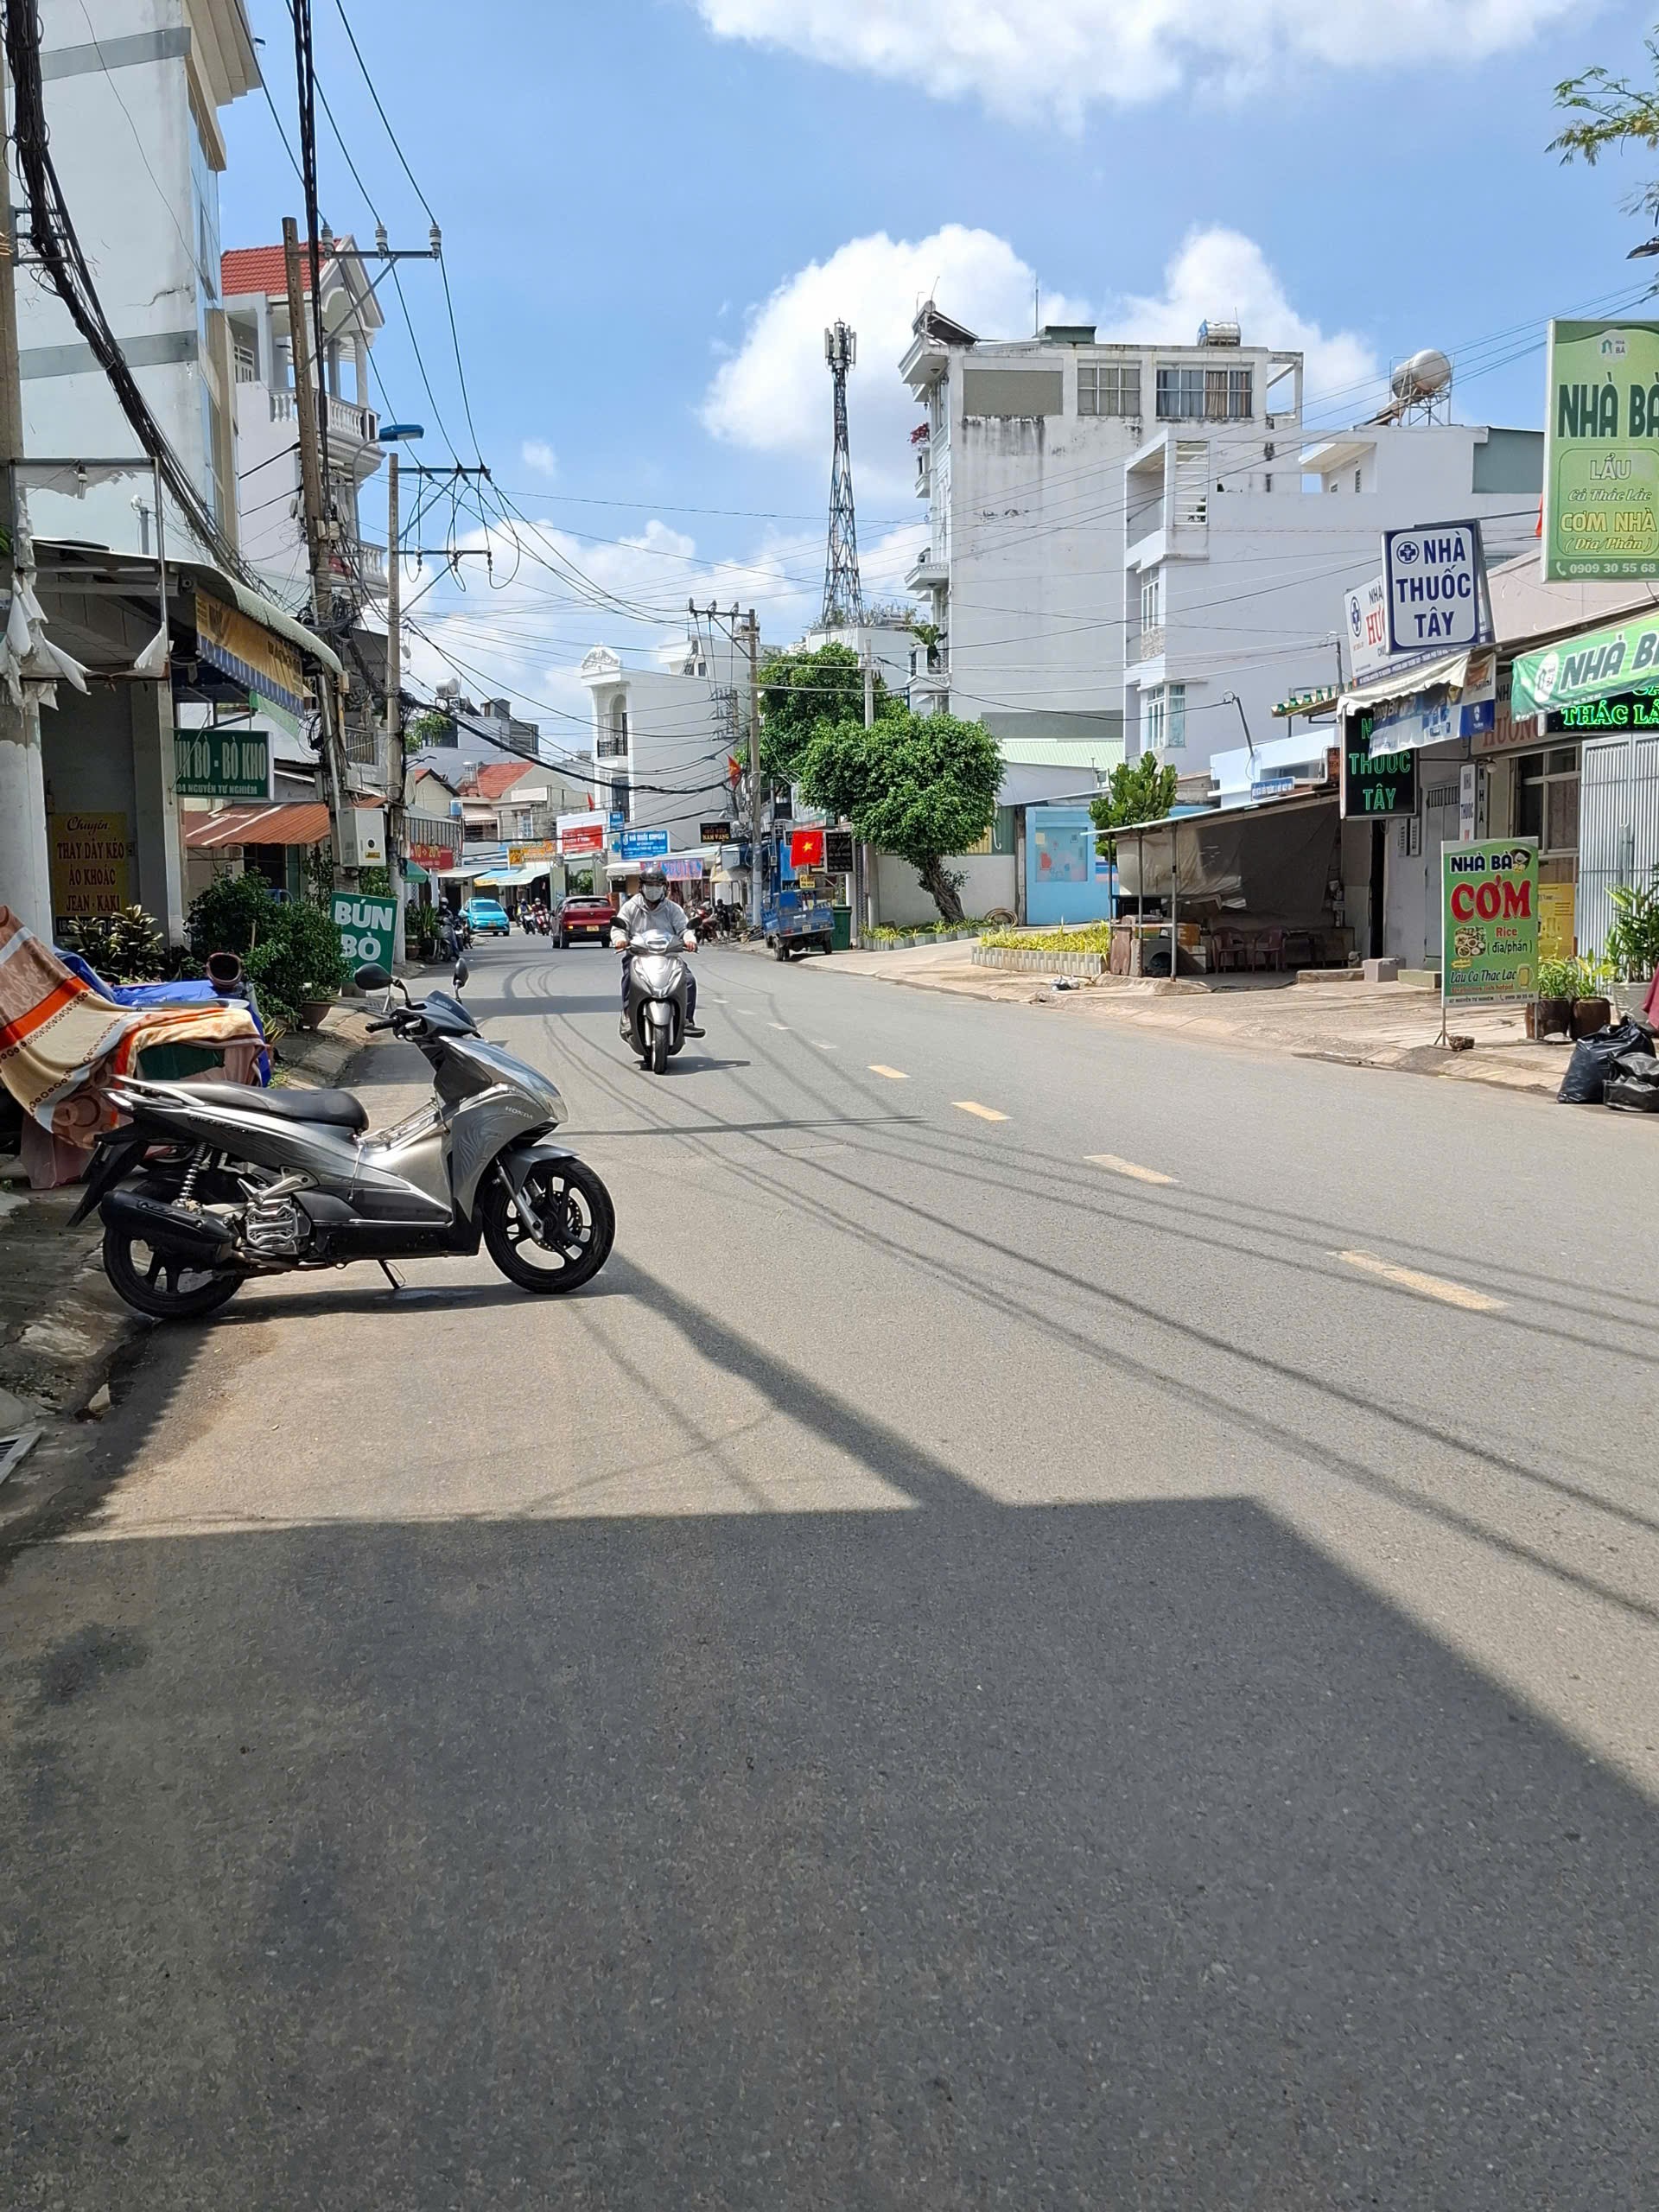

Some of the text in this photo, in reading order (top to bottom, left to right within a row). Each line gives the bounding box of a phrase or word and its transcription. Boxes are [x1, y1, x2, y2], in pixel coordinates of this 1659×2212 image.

[1557, 372, 1619, 438] NHÀ
[1590, 452, 1632, 480] LẨU
[1560, 507, 1658, 532] CƠM NHÀ
[1424, 531, 1466, 564] NHÀ
[1569, 563, 1656, 574] 0909 30 55 68
[1395, 564, 1471, 603] THUỐC
[1414, 606, 1455, 639] TÂY
[1560, 633, 1627, 691] NHÀ
[194, 735, 211, 779] BÒ
[222, 736, 238, 780] BÒ
[242, 741, 266, 781] KHO
[1363, 783, 1397, 811] TÂY
[56, 836, 124, 860] THAY DÂY KÉO
[1451, 851, 1512, 873] NHÀ BÀ
[69, 863, 117, 886] ÁO KHOÁC
[66, 894, 90, 912] JEAN
[96, 894, 121, 912] KAKI
[1451, 874, 1532, 923] CƠM
[334, 899, 394, 931] BÚN
[340, 931, 382, 962] BÒ
[1496, 926, 1518, 938] Rice
